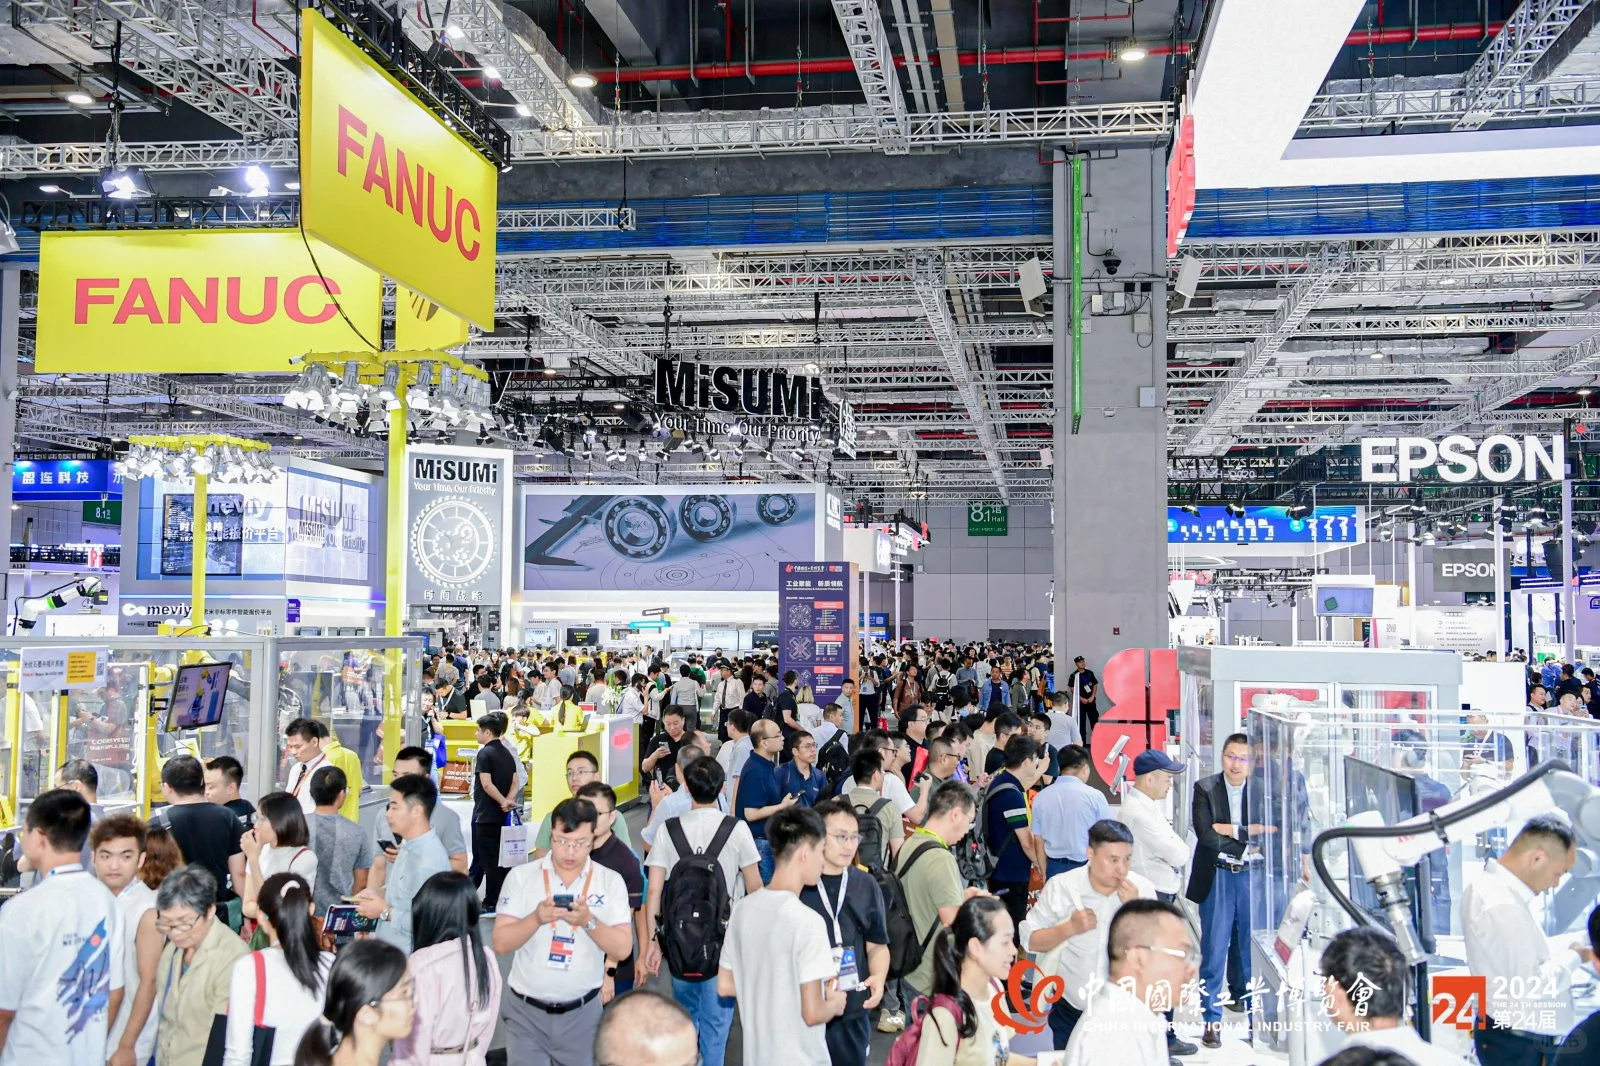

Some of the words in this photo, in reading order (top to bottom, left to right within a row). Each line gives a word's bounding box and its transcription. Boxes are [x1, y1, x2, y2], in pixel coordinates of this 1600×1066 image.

[338, 104, 480, 261] FANUC
[74, 274, 341, 324] FANUC
[654, 412, 690, 431] Your
[738, 419, 767, 437] Our
[768, 424, 820, 445] Priority
[1361, 435, 1565, 482] EPSON
[413, 482, 431, 491] Your
[454, 484, 467, 493] Our
[469, 485, 497, 496] Priority
[971, 502, 990, 522] 8.1
[147, 603, 192, 618] meviy
